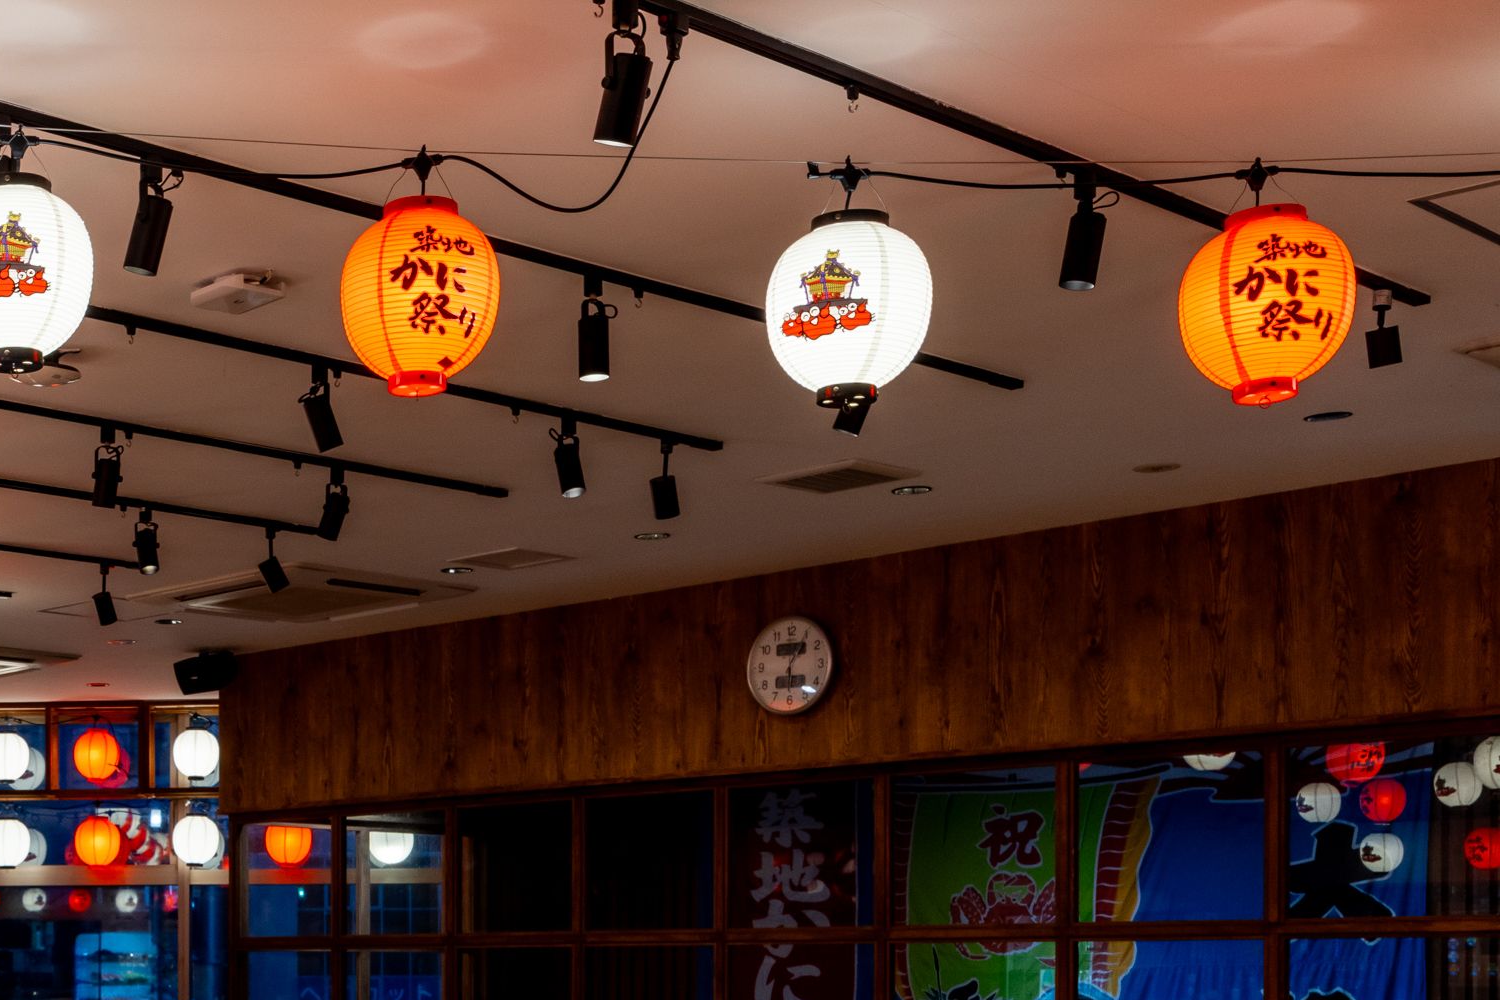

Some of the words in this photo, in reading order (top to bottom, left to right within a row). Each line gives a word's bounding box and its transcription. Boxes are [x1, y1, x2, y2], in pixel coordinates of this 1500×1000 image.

[410, 225, 475, 256] 築地
[1254, 234, 1327, 263] 築地
[390, 254, 467, 293] かに
[1233, 266, 1319, 301] かに
[409, 292, 476, 338] 祭り
[1258, 300, 1333, 341] 祭り
[773, 631, 781, 641] 11
[788, 626, 796, 636] 12
[761, 645, 771, 655] 10
[814, 640, 821, 650] 2
[758, 663, 765, 673] 9
[818, 658, 824, 668] 3
[762, 680, 768, 690] 8
[813, 676, 819, 685] 4
[772, 692, 778, 701] 7
[786, 695, 793, 705] 6
[976, 803, 1045, 868] 祝
